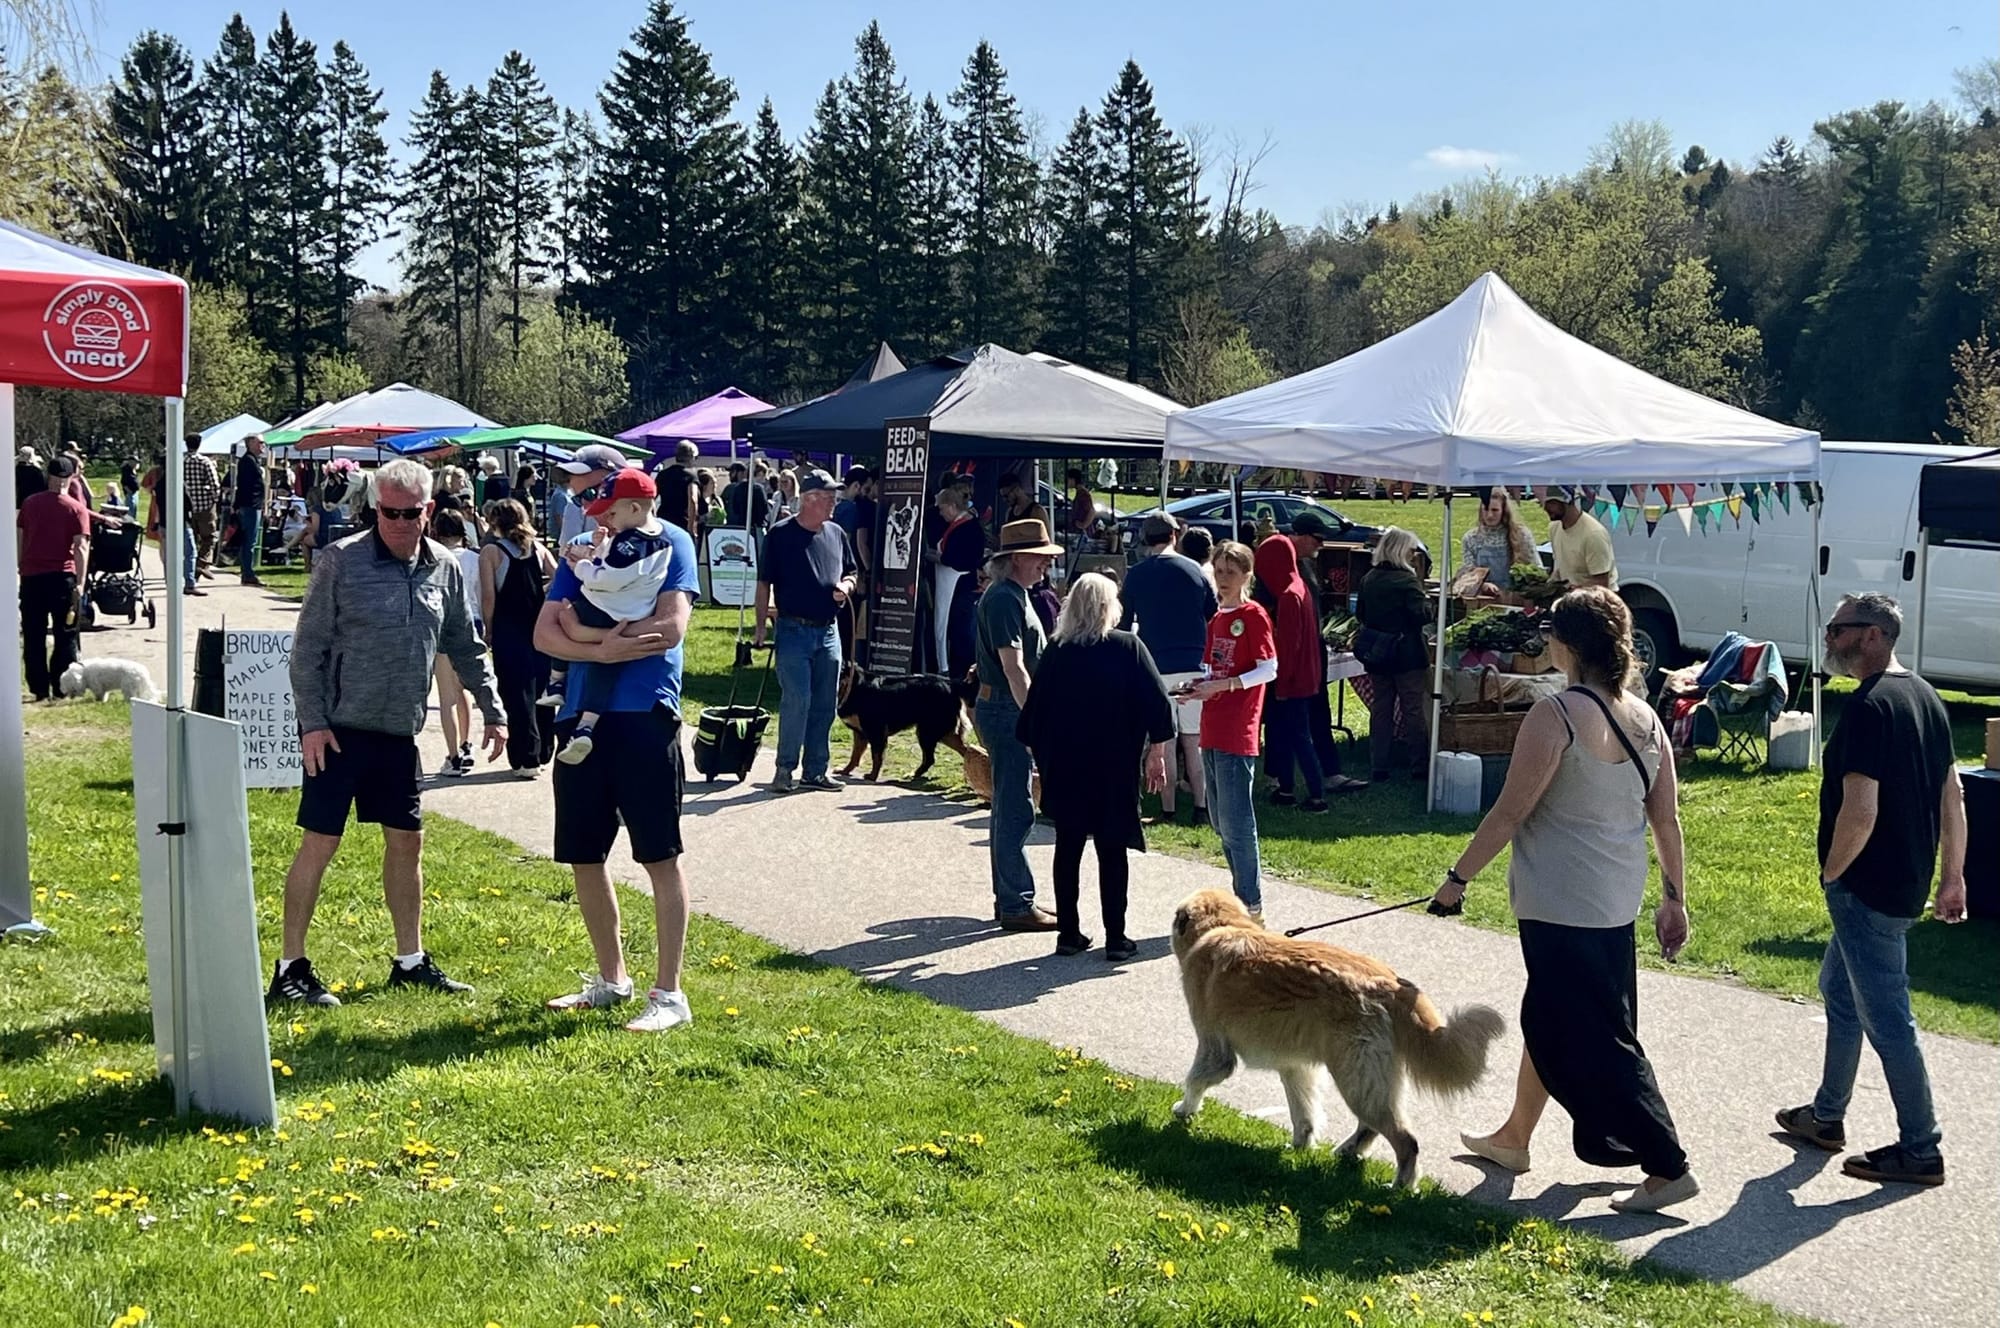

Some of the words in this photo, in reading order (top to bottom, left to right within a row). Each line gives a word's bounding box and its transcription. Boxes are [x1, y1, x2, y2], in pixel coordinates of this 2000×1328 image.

[56, 288, 103, 325] simply
[107, 294, 141, 332] good
[64, 349, 126, 368] meat
[887, 427, 916, 446] FEED
[886, 447, 925, 473] BEAR
[227, 657, 274, 690] MAPLE
[229, 692, 276, 705] MAPLE
[283, 693, 295, 705] S
[229, 708, 276, 722] MAPLE
[244, 757, 268, 769] MS
[277, 757, 303, 769] SAU
